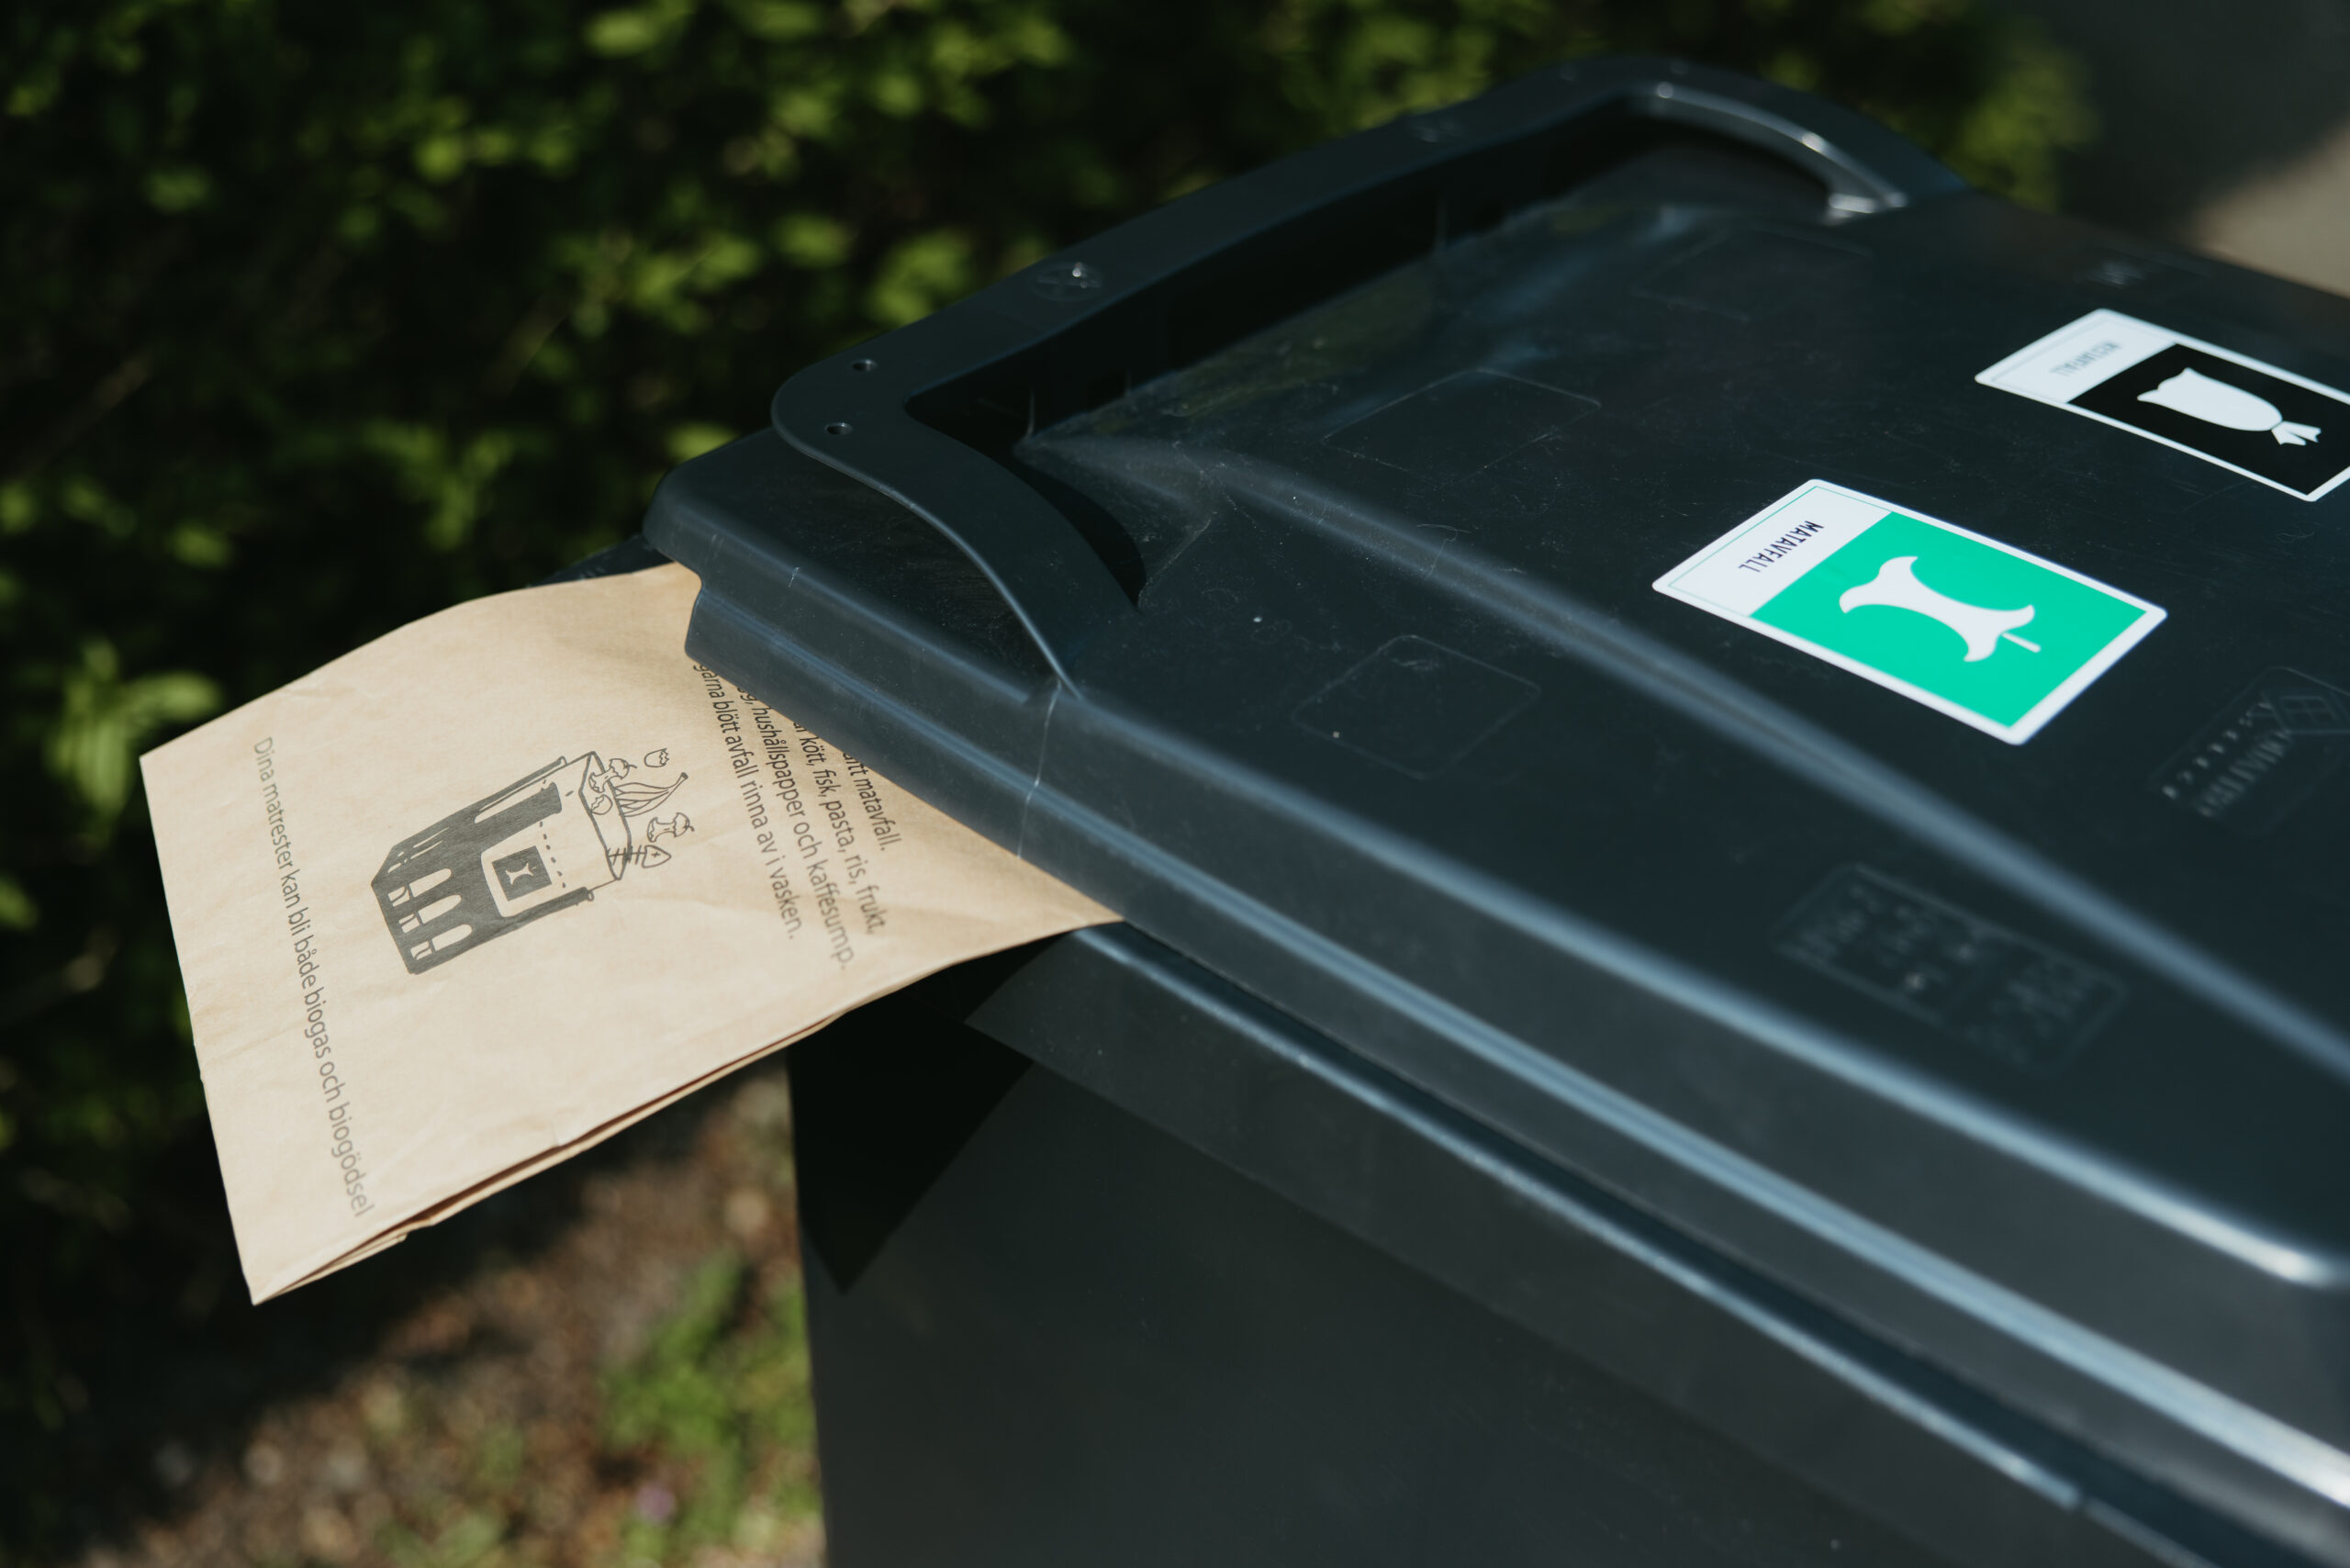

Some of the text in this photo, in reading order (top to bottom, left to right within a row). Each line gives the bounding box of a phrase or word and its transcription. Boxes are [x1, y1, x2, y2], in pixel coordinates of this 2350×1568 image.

[1738, 521, 1824, 573] MATAVFALL
[712, 700, 741, 734] blött
[725, 735, 760, 778] avfall
[799, 736, 827, 766] kött,
[740, 778, 768, 829] rinna
[812, 769, 842, 797] fisk,
[751, 706, 855, 969] hushållspapper och kaffesump.
[819, 801, 855, 853] pasta,
[853, 778, 902, 851] matavfall.
[756, 831, 778, 854] av
[765, 855, 787, 867] i
[844, 854, 868, 884] ris,
[769, 867, 802, 939] vasken.
[856, 884, 889, 935] frukt,
[253, 736, 375, 1217] Dina matrester kan bli både biogas och biogödsel
